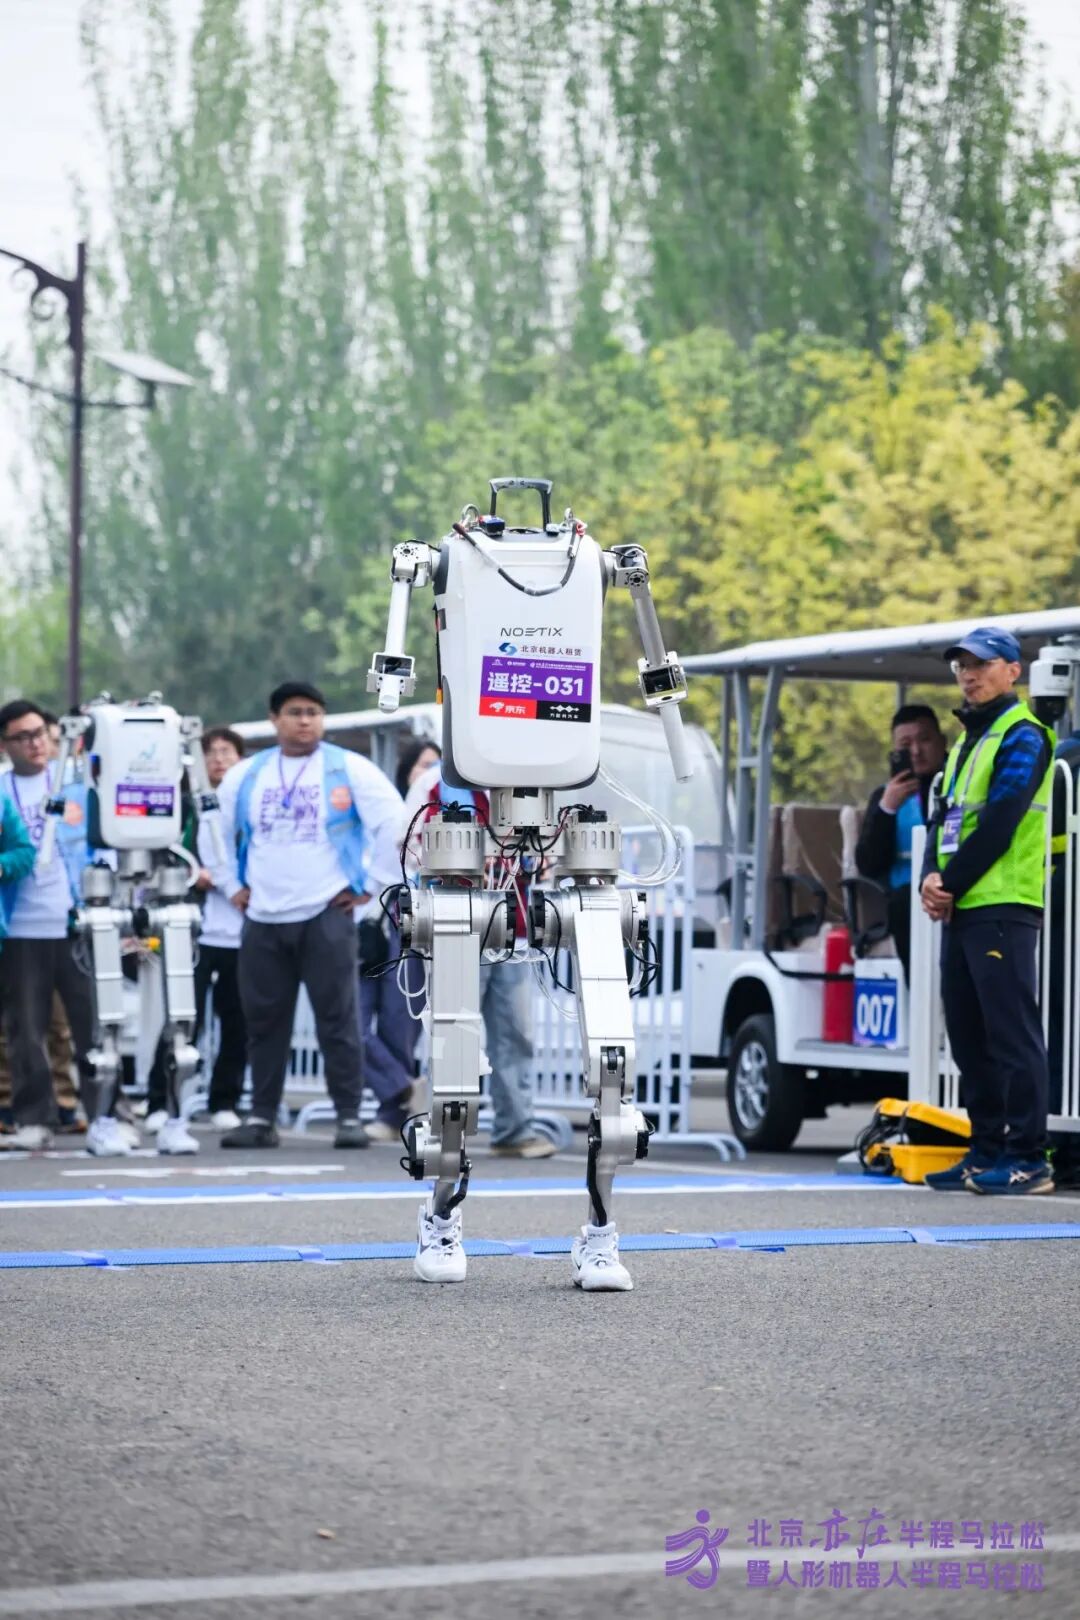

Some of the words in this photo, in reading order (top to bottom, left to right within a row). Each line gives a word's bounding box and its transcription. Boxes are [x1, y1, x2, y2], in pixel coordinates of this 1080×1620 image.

[500, 627, 563, 637] NOETIX
[520, 645, 582, 657] 北京机器人租赁
[487, 672, 584, 697] 遥控-031
[505, 704, 527, 715] 京东
[857, 993, 895, 1037] 007
